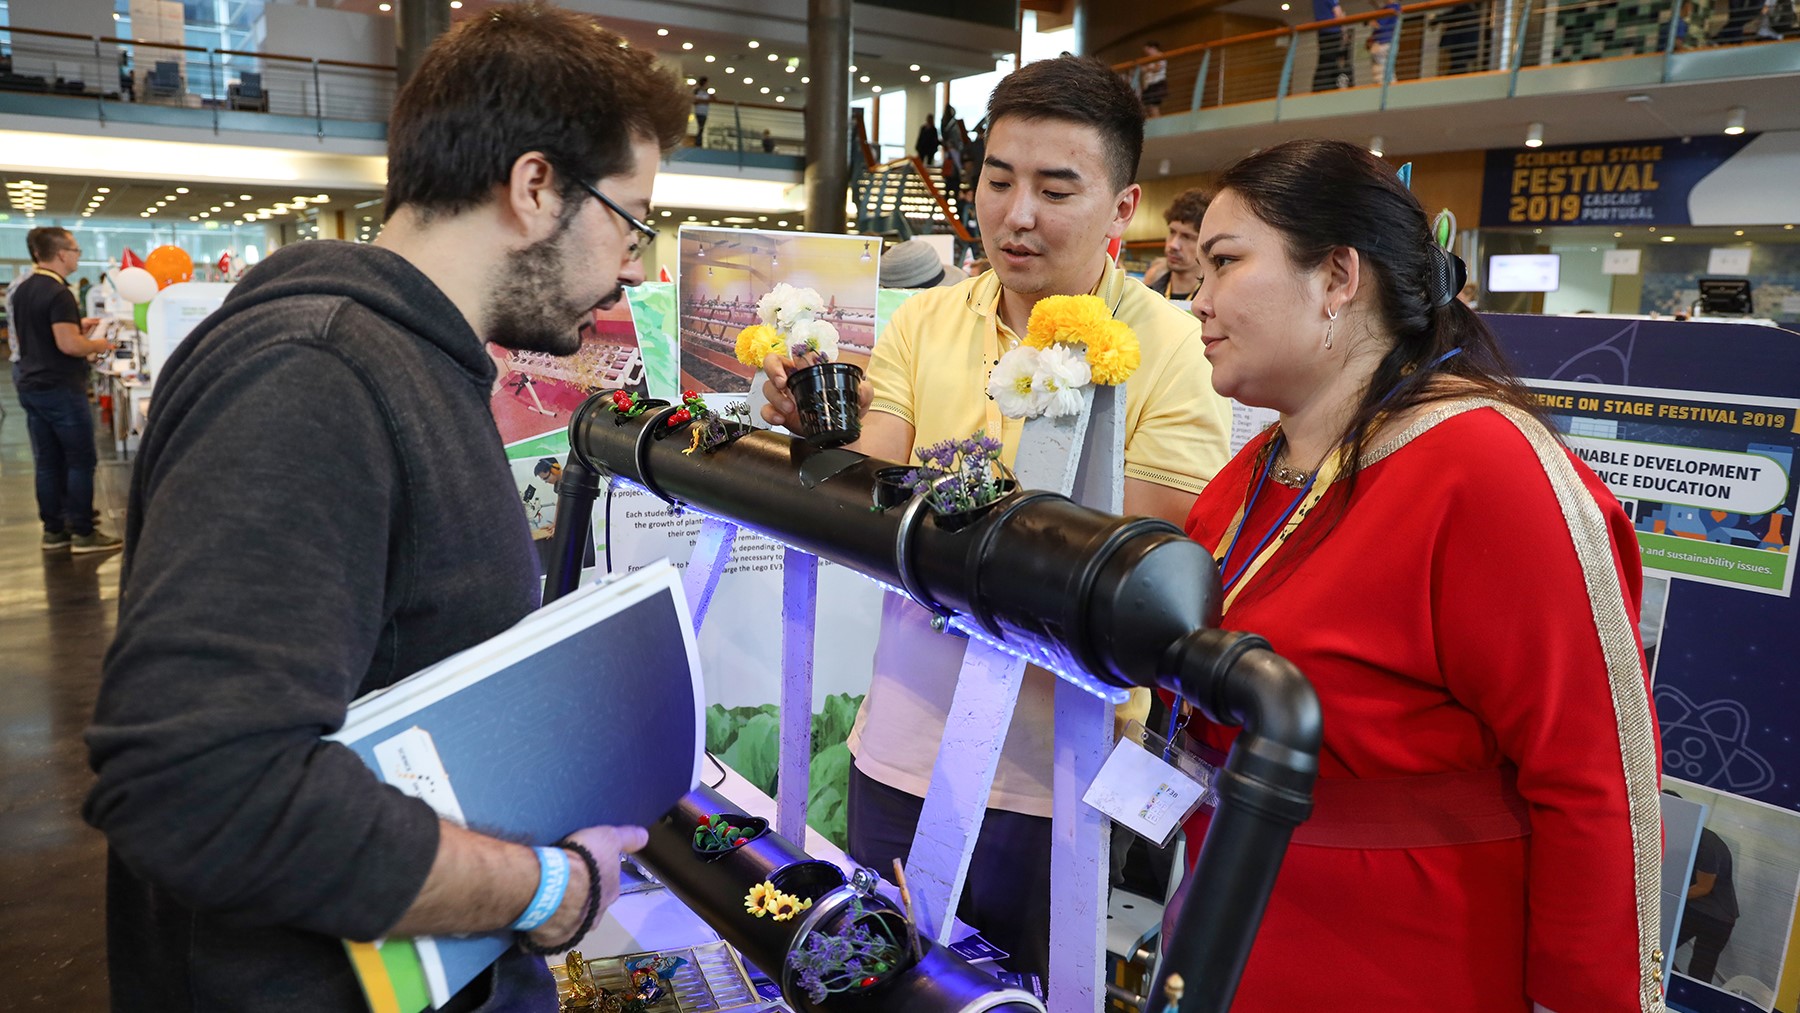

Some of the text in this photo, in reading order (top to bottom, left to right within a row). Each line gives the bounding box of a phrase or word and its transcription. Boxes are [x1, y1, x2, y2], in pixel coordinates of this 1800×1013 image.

[1514, 147, 1663, 166] SCIENCE ON STAGE
[1511, 164, 1659, 193] FESTIVAL
[1508, 193, 1642, 222] 2019 CASCAIS
[1581, 206, 1655, 220] PORTUGAL
[1577, 397, 1599, 412] ON
[1603, 400, 1655, 417] STAGE
[1658, 404, 1738, 424] FESTIVAL
[1742, 412, 1786, 428] 2019
[1633, 454, 1761, 481] DEVELOPMENT
[1632, 475, 1732, 500] EDUCATION
[626, 510, 643, 519] Each
[648, 519, 675, 530] growth
[676, 517, 684, 526] of
[668, 530, 685, 538] their
[738, 544, 776, 552] depending
[770, 563, 783, 571] EV3
[1646, 546, 1665, 557] and
[1666, 549, 1735, 570] sustainability
[1737, 560, 1773, 575] issues.
